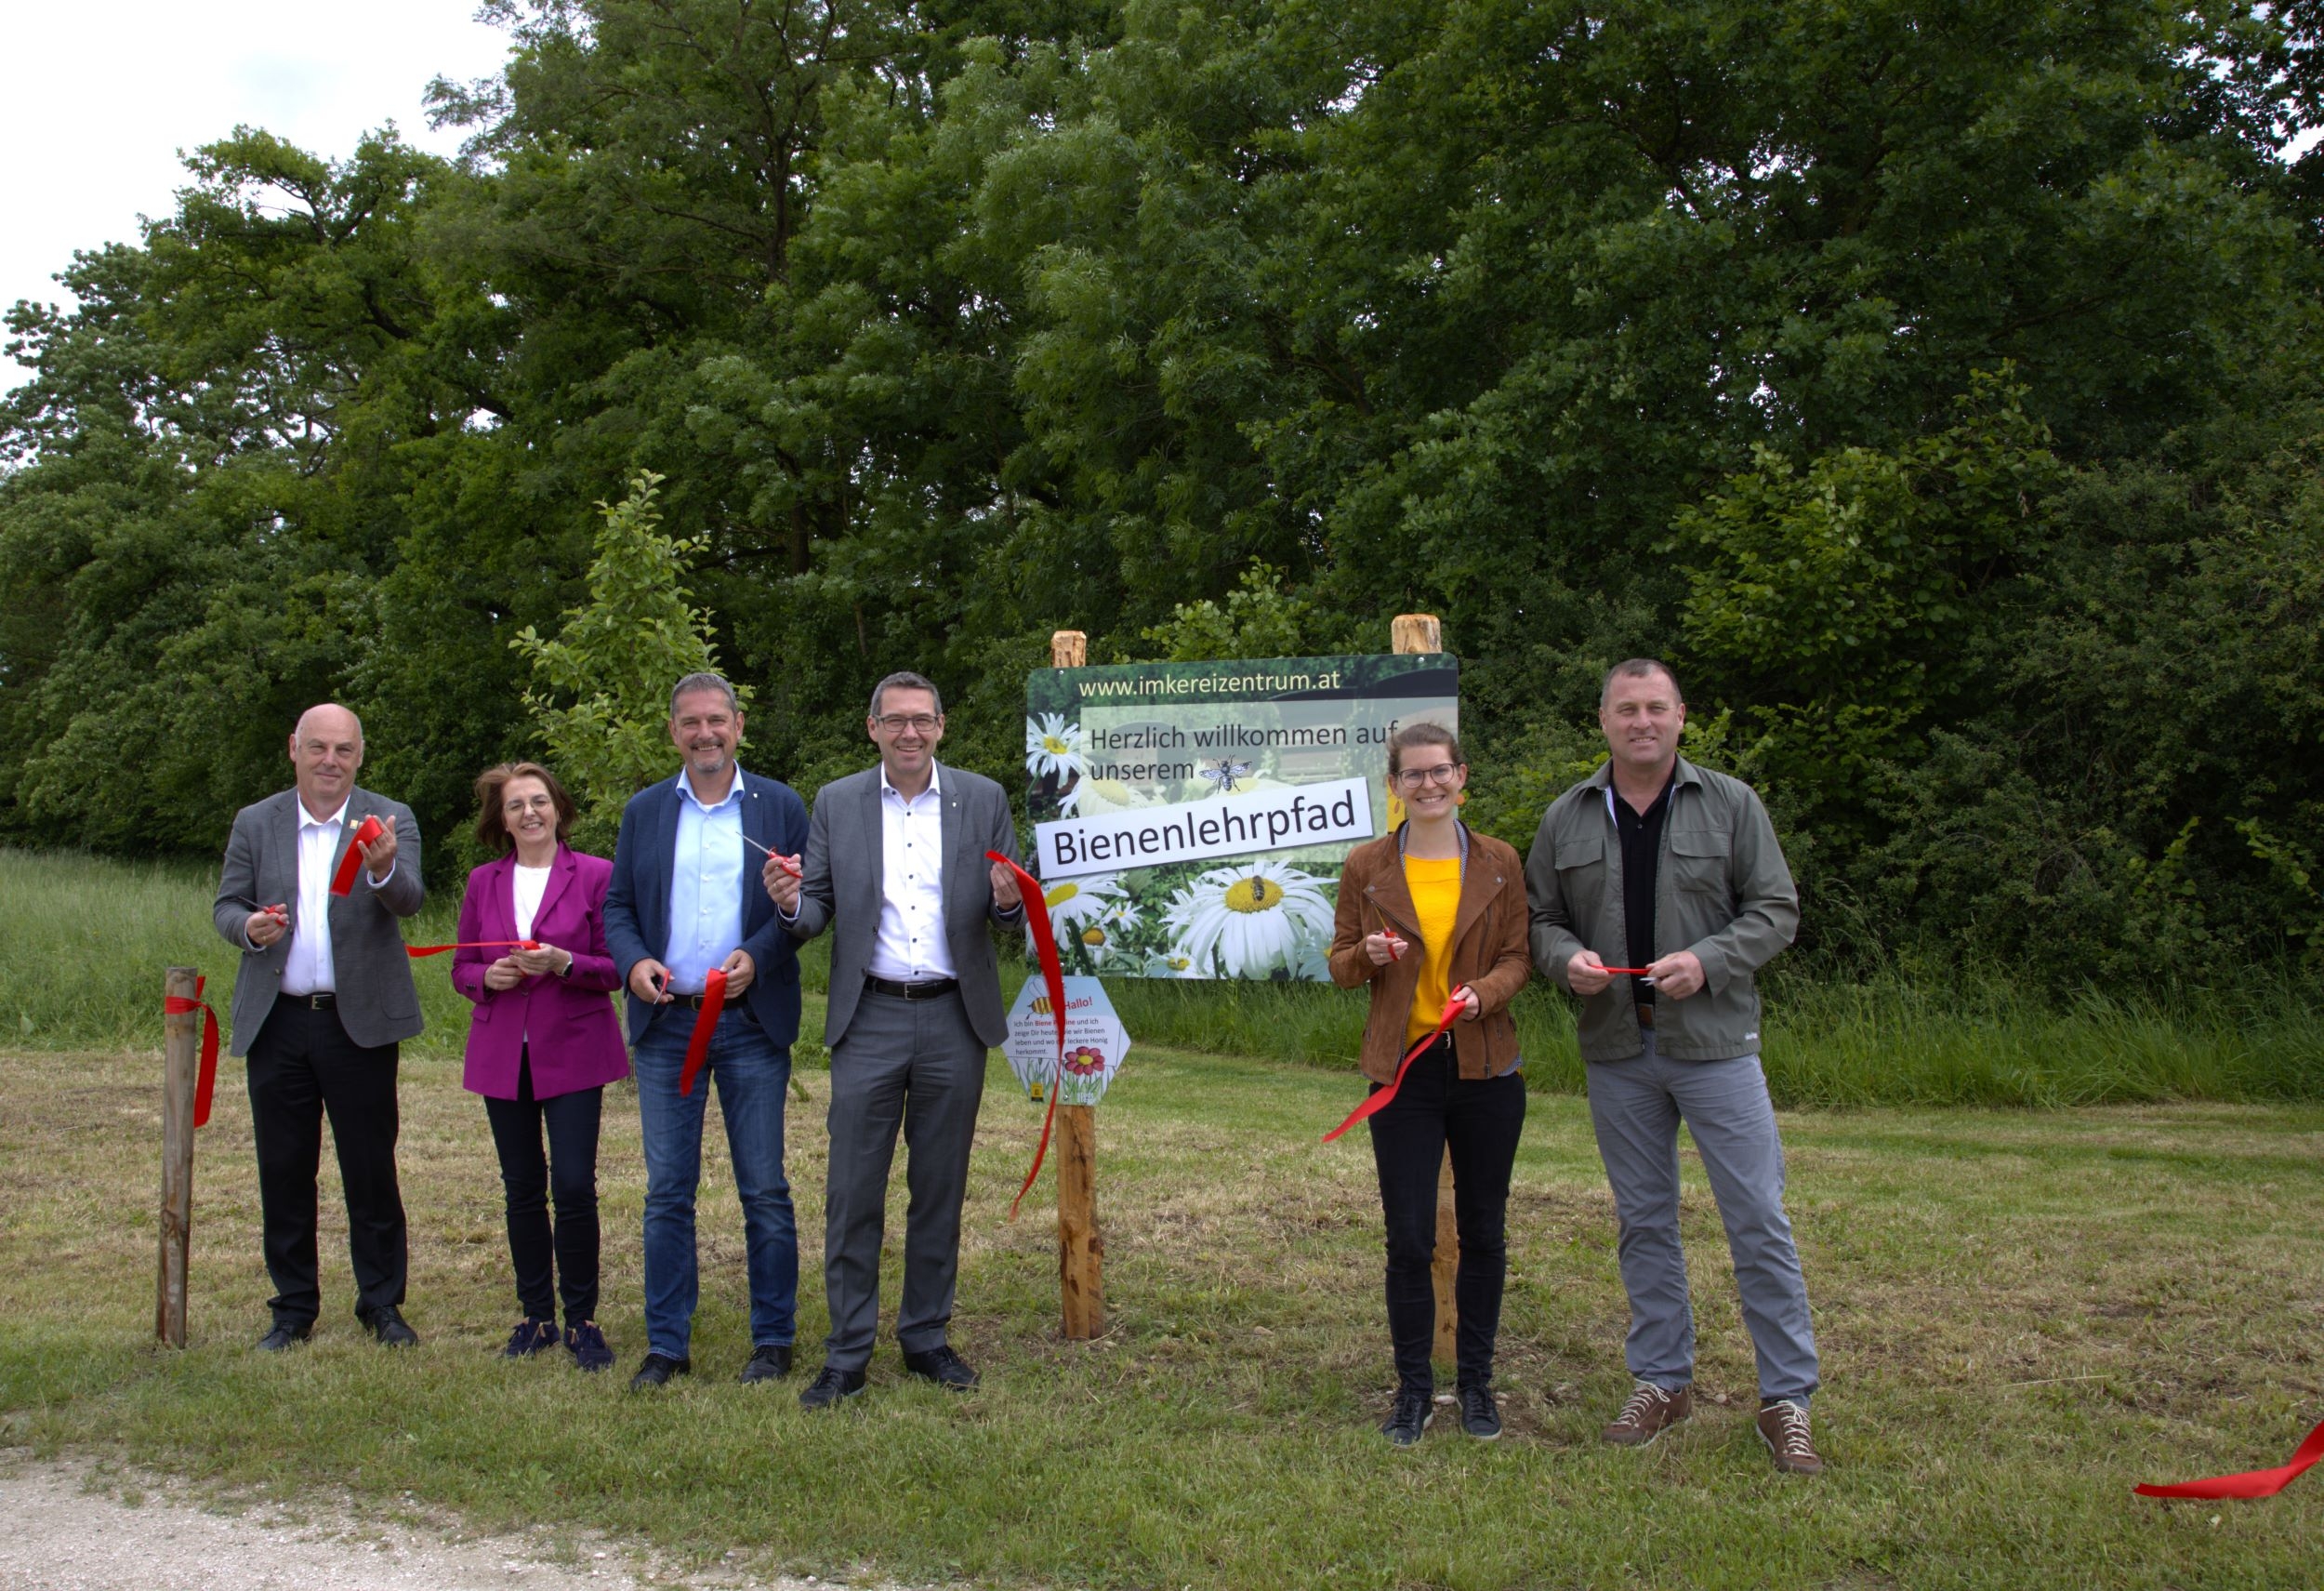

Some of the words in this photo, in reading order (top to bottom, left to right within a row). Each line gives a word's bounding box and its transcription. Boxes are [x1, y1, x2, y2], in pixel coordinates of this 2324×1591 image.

[1078, 670, 1340, 697] www.imkereizentrum.at
[1090, 724, 1186, 750] Herzlich
[1194, 723, 1347, 748] willkommen
[1355, 719, 1399, 745] auf
[1090, 761, 1195, 781] unserem
[1053, 789, 1356, 867] Bienenlehrpfad
[1064, 996, 1093, 1010] Hallo!
[1089, 1037, 1108, 1045] Honig
